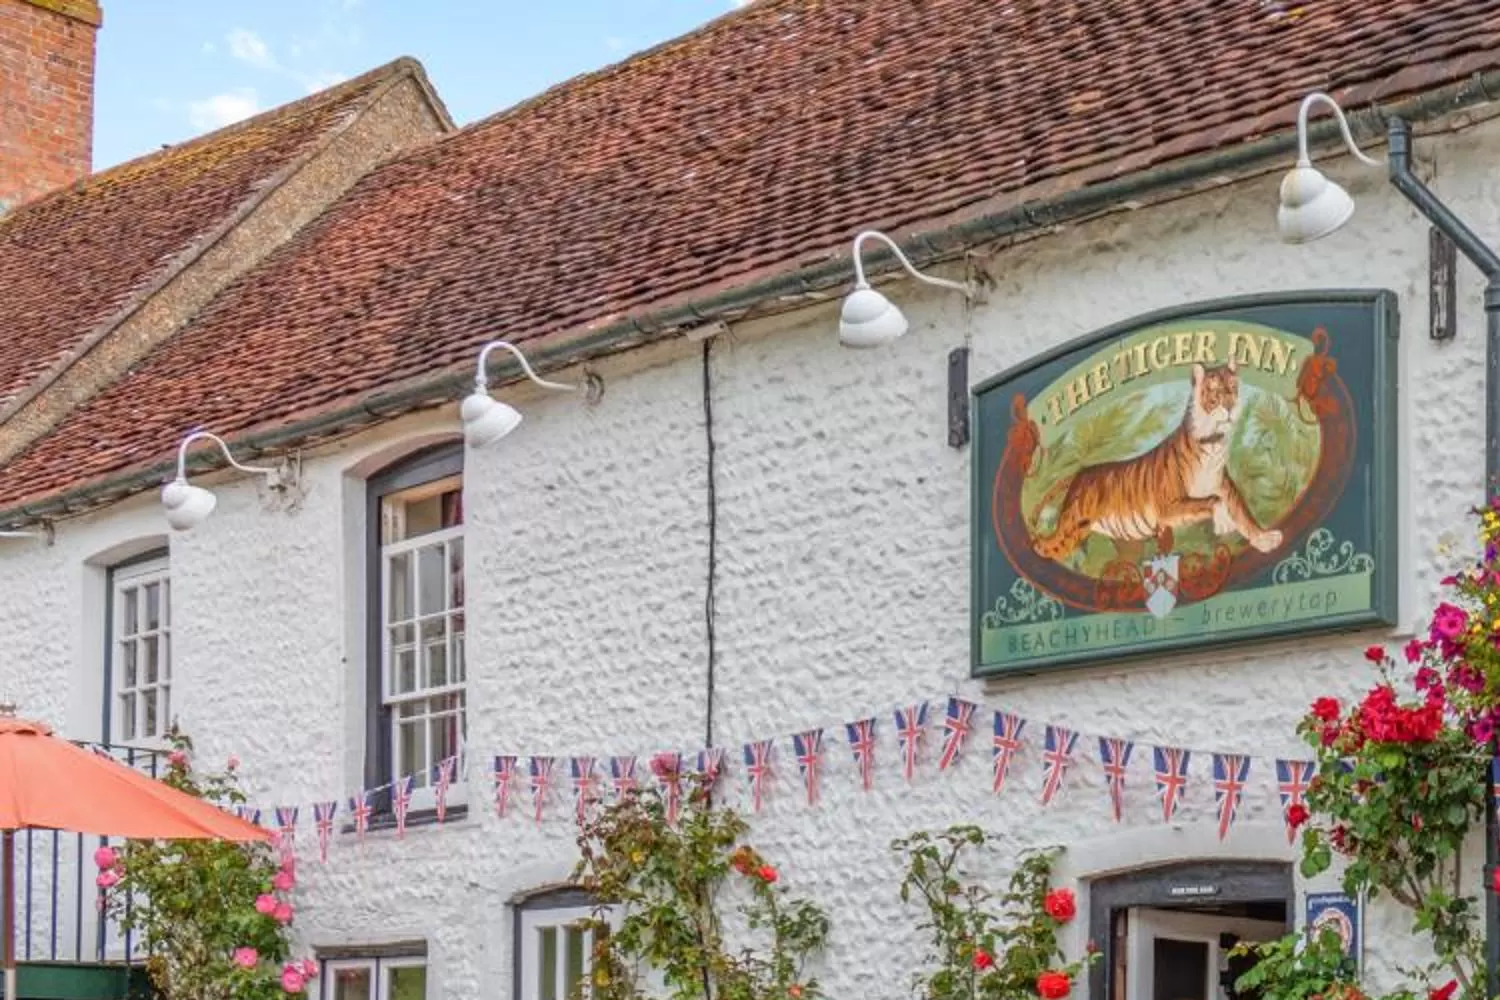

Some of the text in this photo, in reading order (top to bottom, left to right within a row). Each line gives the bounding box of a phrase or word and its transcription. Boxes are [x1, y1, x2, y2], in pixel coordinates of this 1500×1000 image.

[1047, 331, 1297, 425] THE TIGER INN
